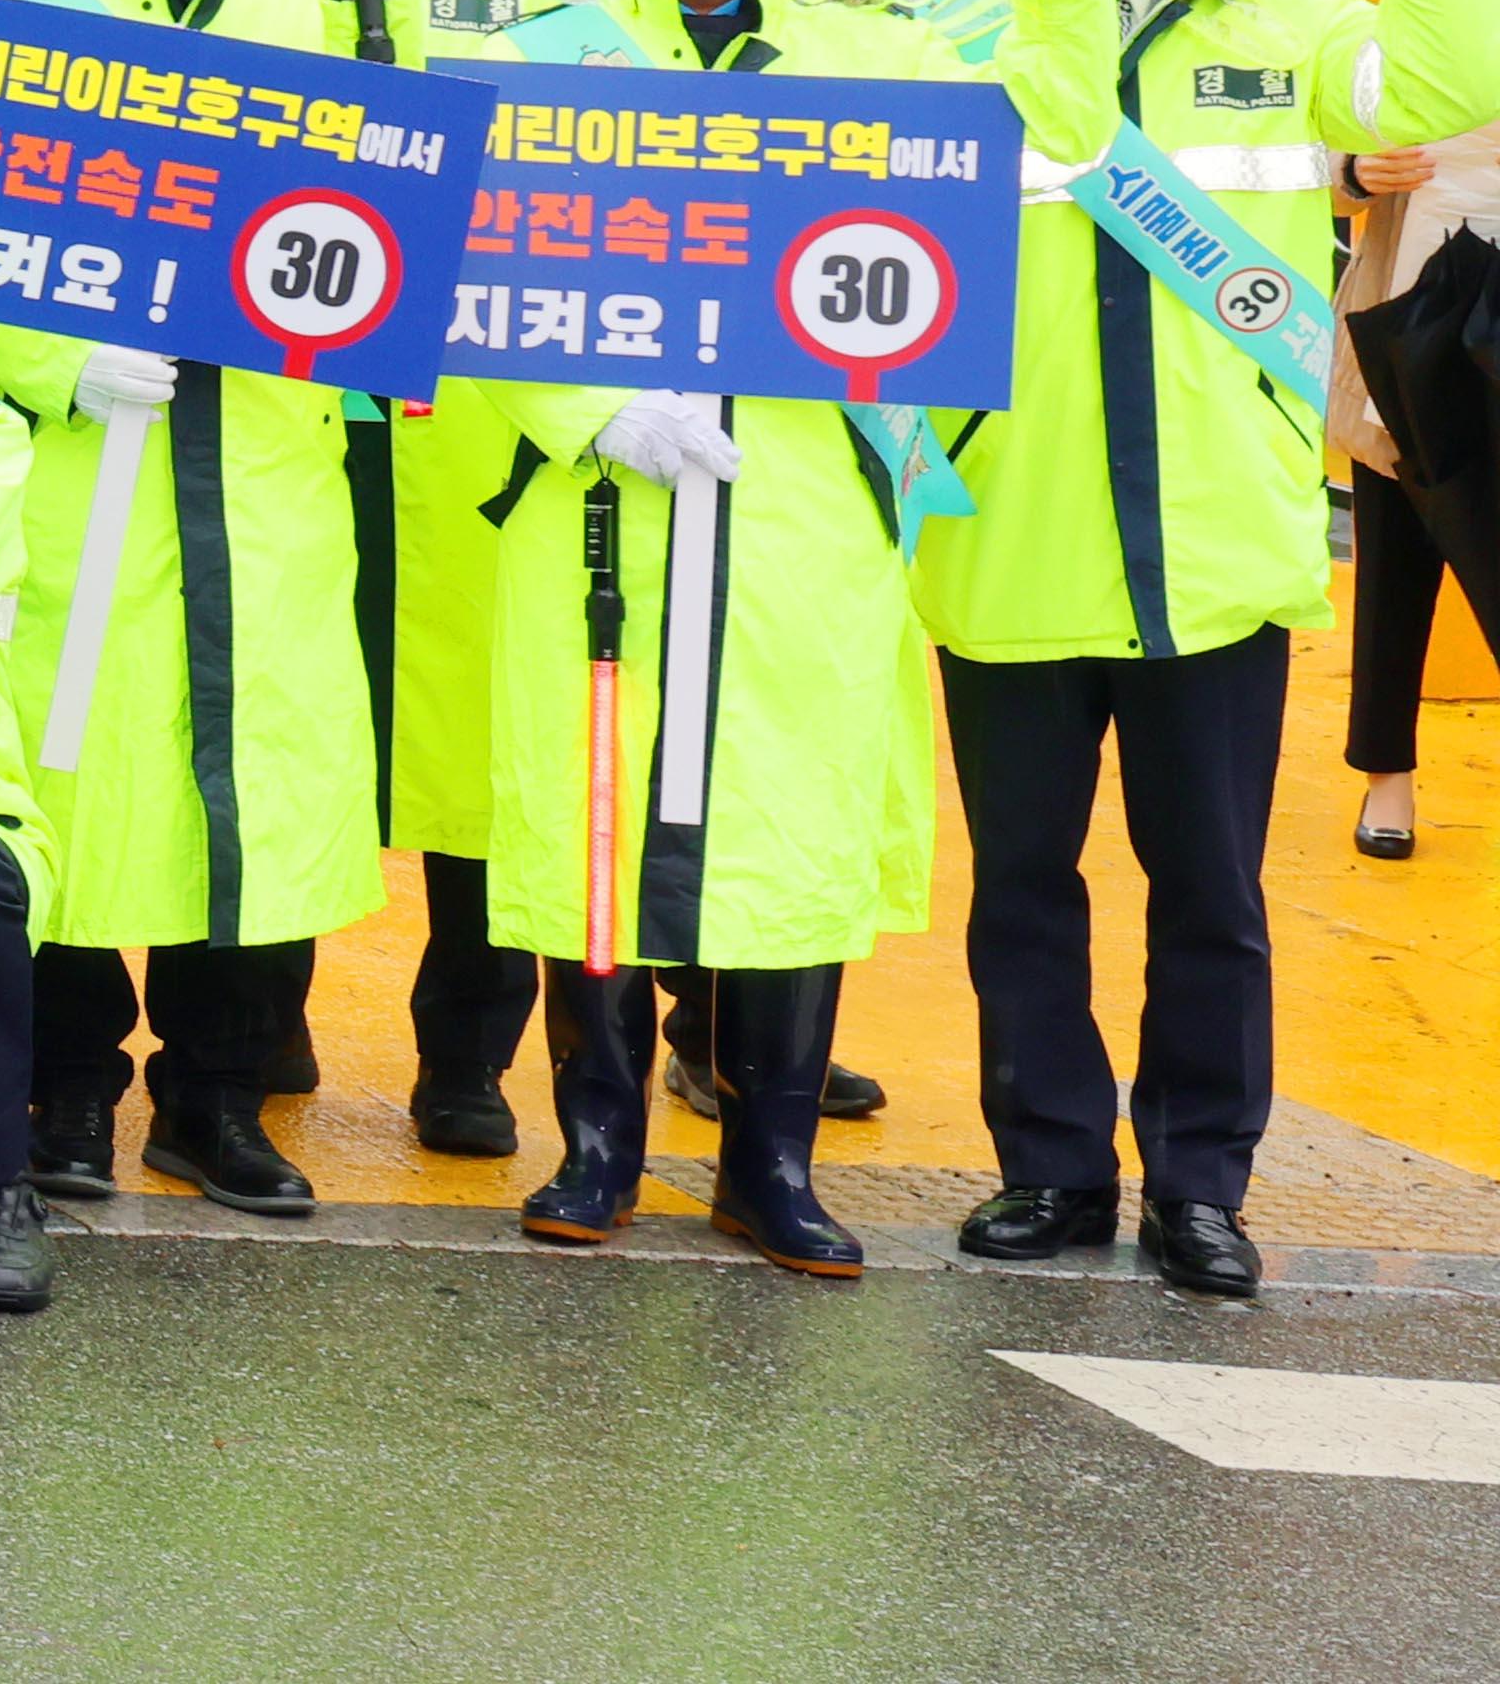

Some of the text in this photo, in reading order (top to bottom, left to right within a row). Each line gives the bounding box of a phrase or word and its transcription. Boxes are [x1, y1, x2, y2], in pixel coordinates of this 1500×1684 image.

[1195, 94, 1293, 109] NATIONAL POLICE
[1197, 68, 1290, 95] 경찰
[269, 228, 361, 309] 30
[818, 252, 911, 326] 30
[1229, 277, 1281, 324] 30
